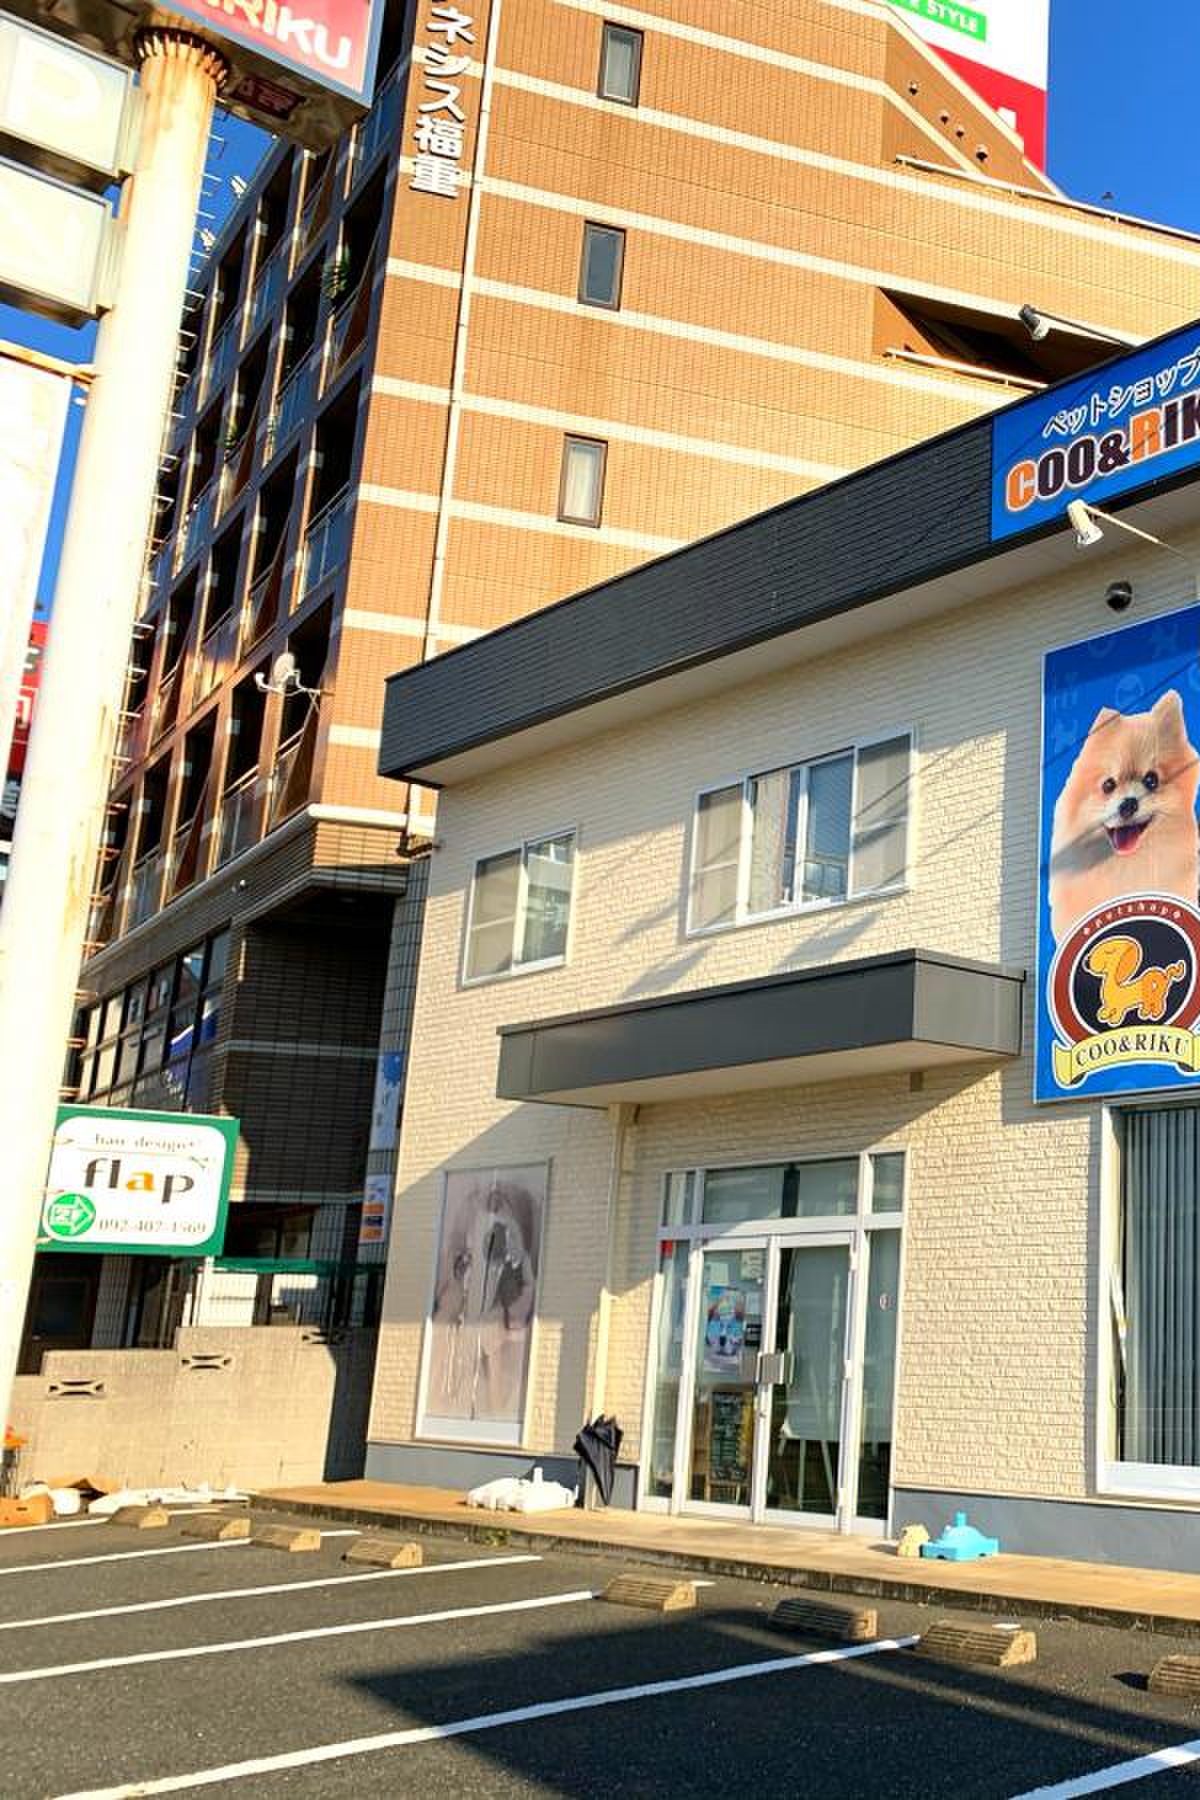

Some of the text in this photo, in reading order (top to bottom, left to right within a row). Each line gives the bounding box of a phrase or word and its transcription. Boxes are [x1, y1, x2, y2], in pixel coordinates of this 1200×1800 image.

[196, 0, 352, 69] RIKU
[1075, 1032, 1189, 1067] COO&RIKU
[83, 1158, 195, 1204] flap
